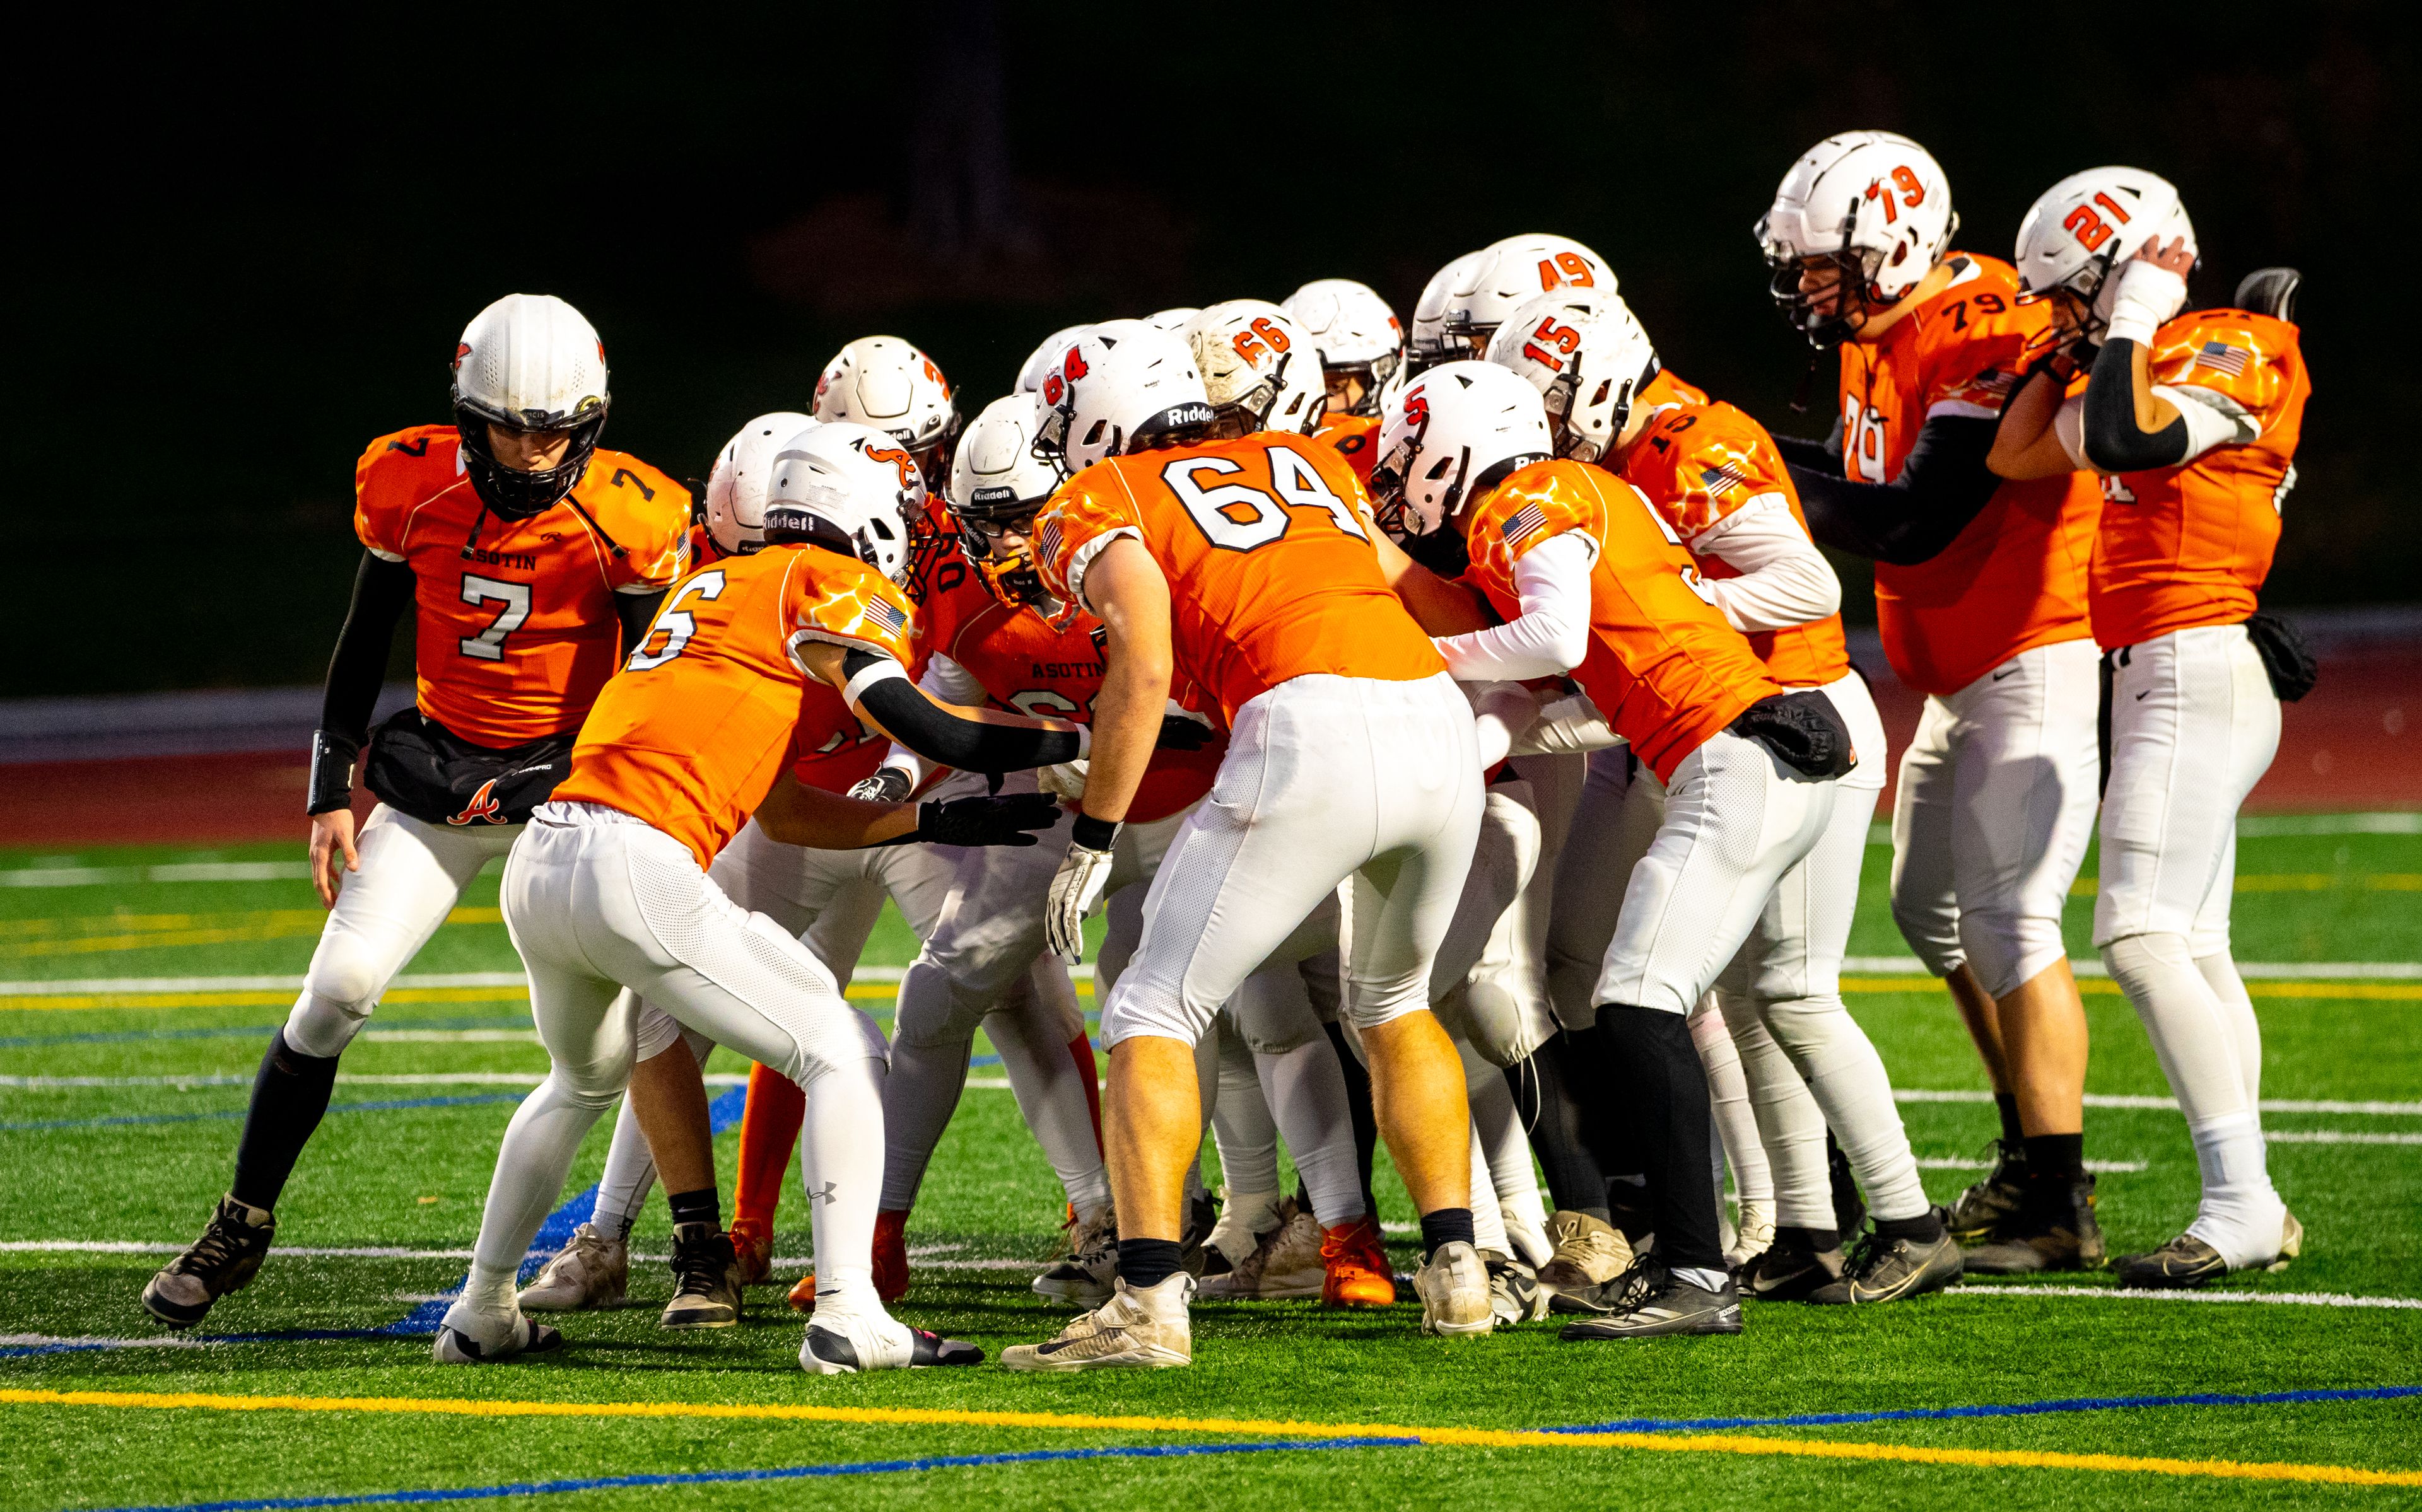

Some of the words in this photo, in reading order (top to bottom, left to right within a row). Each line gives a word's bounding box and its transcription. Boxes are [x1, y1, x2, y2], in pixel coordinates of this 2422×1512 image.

[1864, 165, 1924, 225] 79
[2064, 191, 2131, 253] 21
[1538, 252, 1594, 293] 49
[1941, 293, 2006, 333] 79
[1232, 317, 1290, 371] 66
[1523, 316, 1581, 373] 15
[1043, 344, 1089, 406] 64
[1403, 383, 1429, 426] 5
[1844, 391, 1886, 485] 79
[610, 467, 656, 503] 7
[974, 489, 1010, 501] Riddell
[1160, 446, 1371, 554] 64
[469, 549, 535, 571] SOTIN
[459, 571, 533, 663] 7
[625, 569, 727, 673] 6
